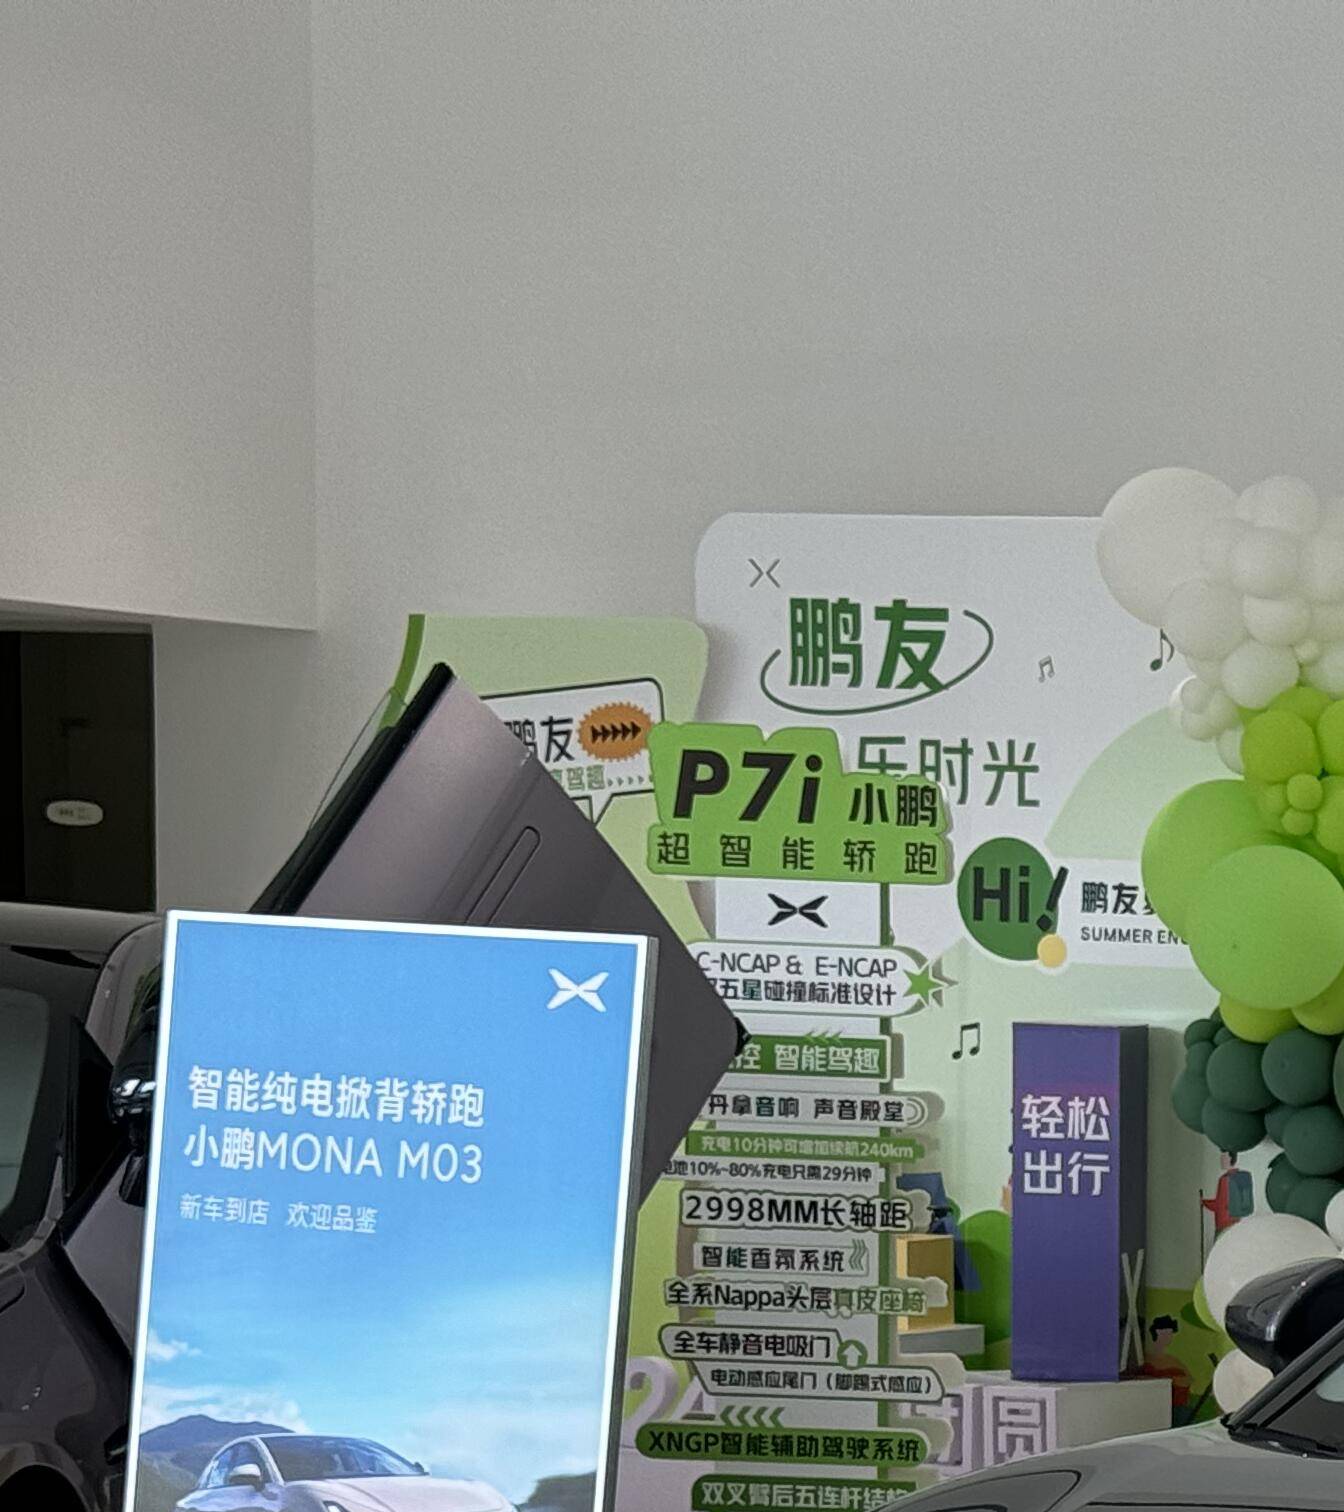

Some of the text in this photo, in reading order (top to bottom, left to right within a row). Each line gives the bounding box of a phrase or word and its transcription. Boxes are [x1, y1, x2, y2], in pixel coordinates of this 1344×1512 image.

[789, 597, 950, 692] 鹏友
[673, 748, 938, 828] P7i 小鹏
[657, 832, 937, 876] 超智能轿跑
[973, 865, 1069, 931] Hi!
[1080, 881, 1155, 915] 鹏友
[1080, 927, 1153, 944] SUMMER
[696, 951, 781, 975] C-NCAP
[815, 957, 898, 979] E-NCAP
[728, 1043, 762, 1071] 控
[188, 1065, 485, 1128] 智能纯电掀背轿跑
[814, 1098, 905, 1123] 声音殿堂
[1021, 1094, 1111, 1144] 轻松
[183, 1124, 484, 1185] 小鹏MONA M03
[1022, 1150, 1111, 1197] 出行
[180, 1193, 379, 1235] 新车到店 欢迎品鉴
[684, 1195, 908, 1229] 2998MM长轴距
[701, 1245, 846, 1273] 智能香氛系统
[667, 1281, 927, 1314] 全系Nappa头层真皮座椅
[673, 1330, 831, 1358] 全车静音电吸门
[648, 1431, 921, 1462] XNGP智能辅助驾驶系统
